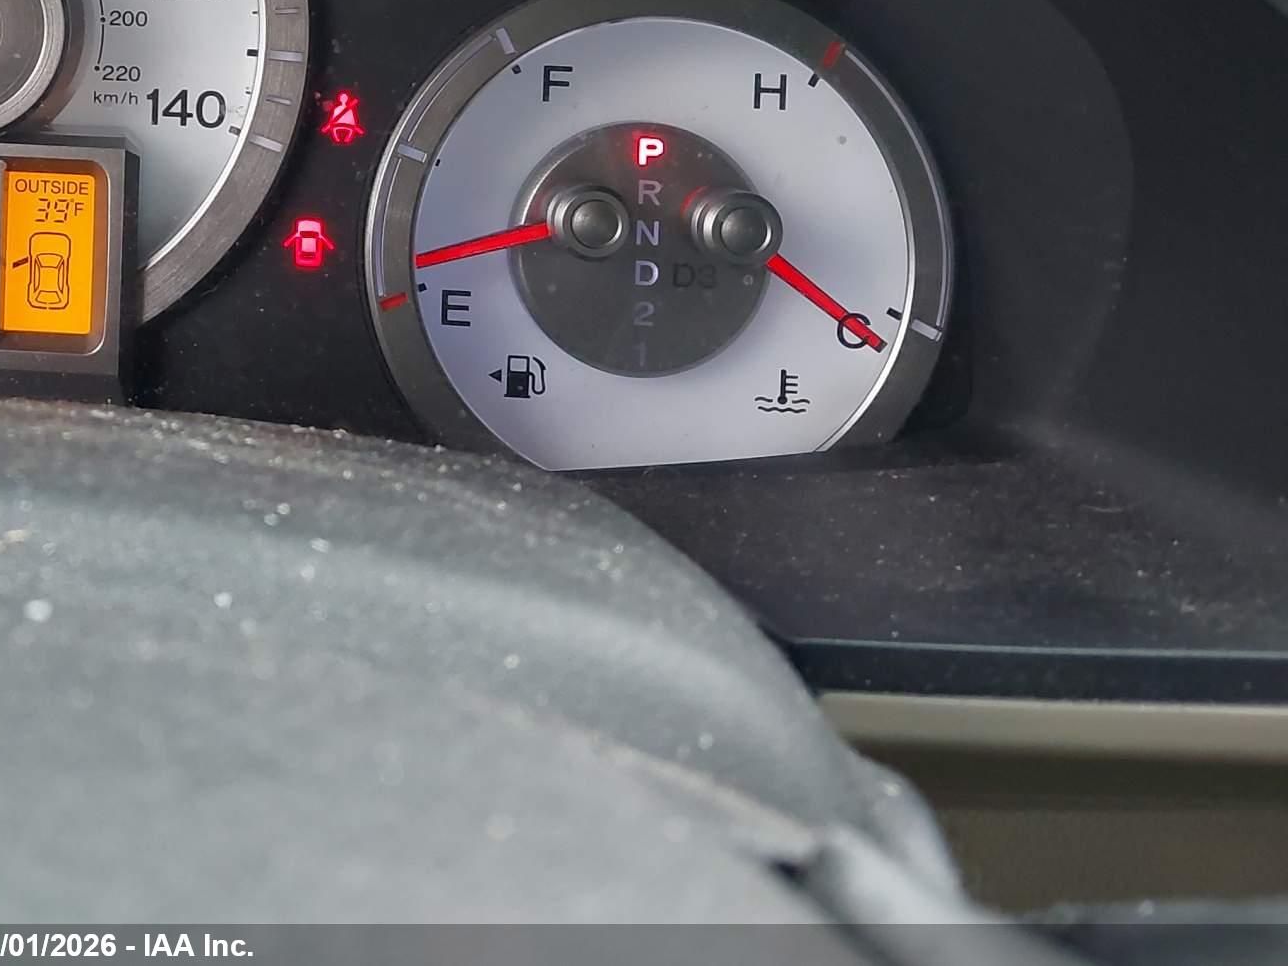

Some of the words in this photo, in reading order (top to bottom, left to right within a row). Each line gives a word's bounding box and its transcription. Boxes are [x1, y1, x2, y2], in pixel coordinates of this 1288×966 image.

[109, 11, 147, 27] 200
[102, 65, 140, 82] 220
[542, 66, 573, 102] F
[93, 91, 138, 106] km/h
[753, 73, 787, 110] H
[146, 89, 225, 129] 140
[638, 138, 664, 165] P
[15, 178, 89, 196] OUTSIDE
[638, 179, 662, 206] R
[636, 220, 659, 246] N
[635, 260, 659, 286] D
[441, 290, 472, 326] E
[633, 301, 655, 326] 2
[837, 313, 871, 349] C
